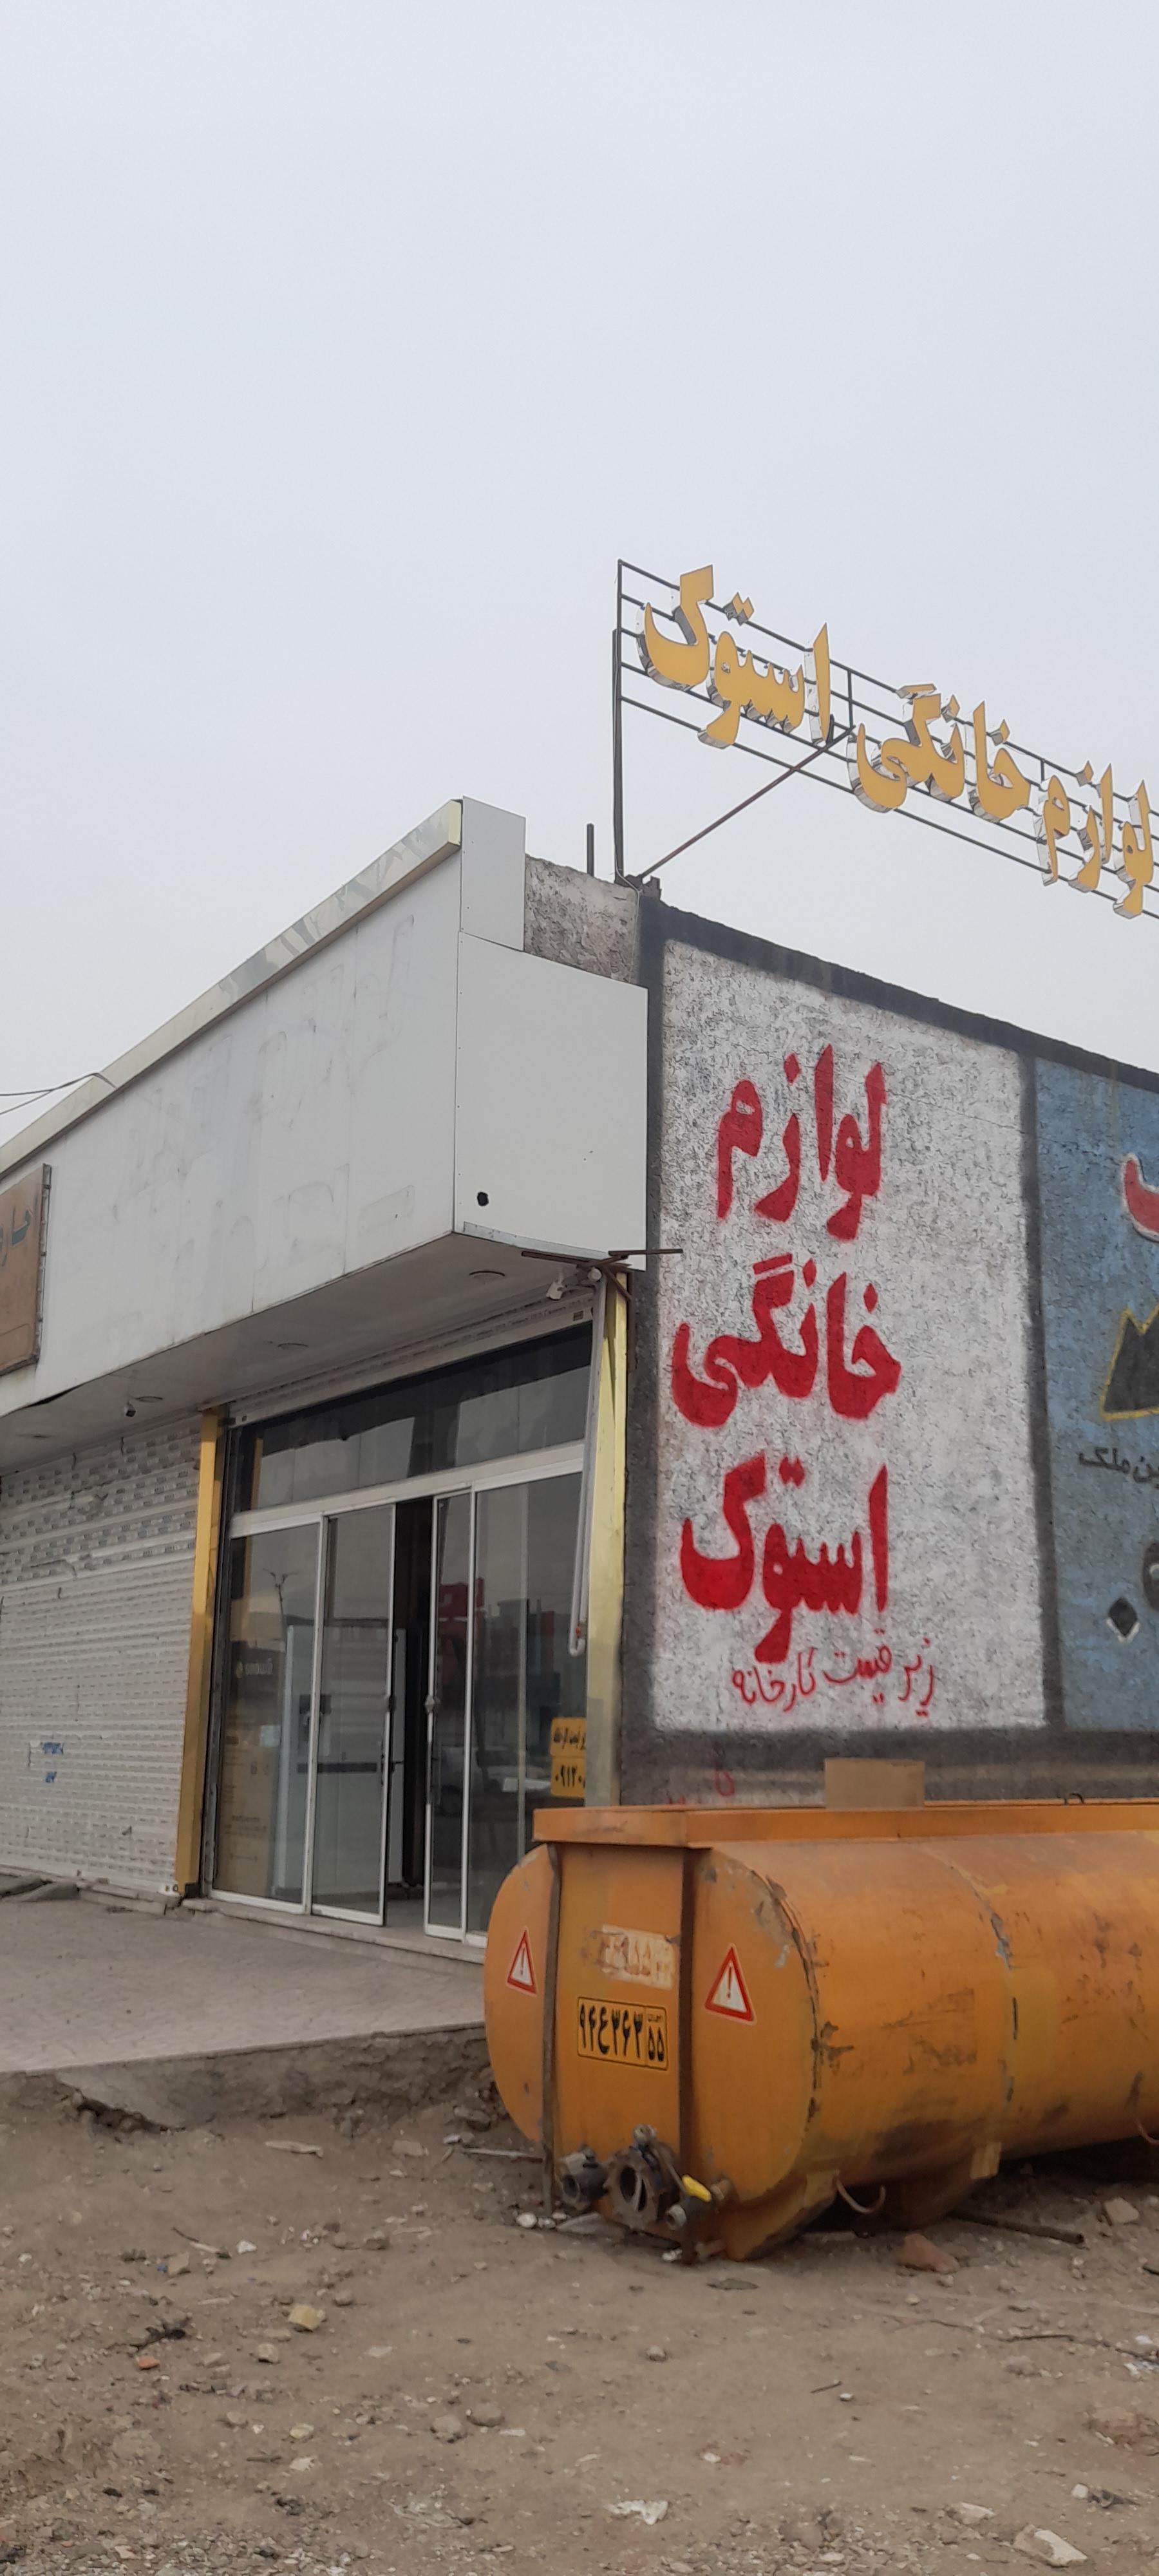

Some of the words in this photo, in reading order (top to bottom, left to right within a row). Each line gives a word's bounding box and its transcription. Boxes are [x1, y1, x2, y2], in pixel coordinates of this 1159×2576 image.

[643, 564, 831, 746] استوک
[856, 684, 1031, 820] خانگی
[1042, 762, 1154, 915] لوازم
[716, 1044, 887, 1242] لوازم
[670, 1253, 902, 1430] خانگی
[679, 1451, 889, 1665] استوک
[730, 1647, 817, 1712] کارخانه
[822, 1628, 892, 1705] قیمت
[898, 1638, 934, 1718] زیر
